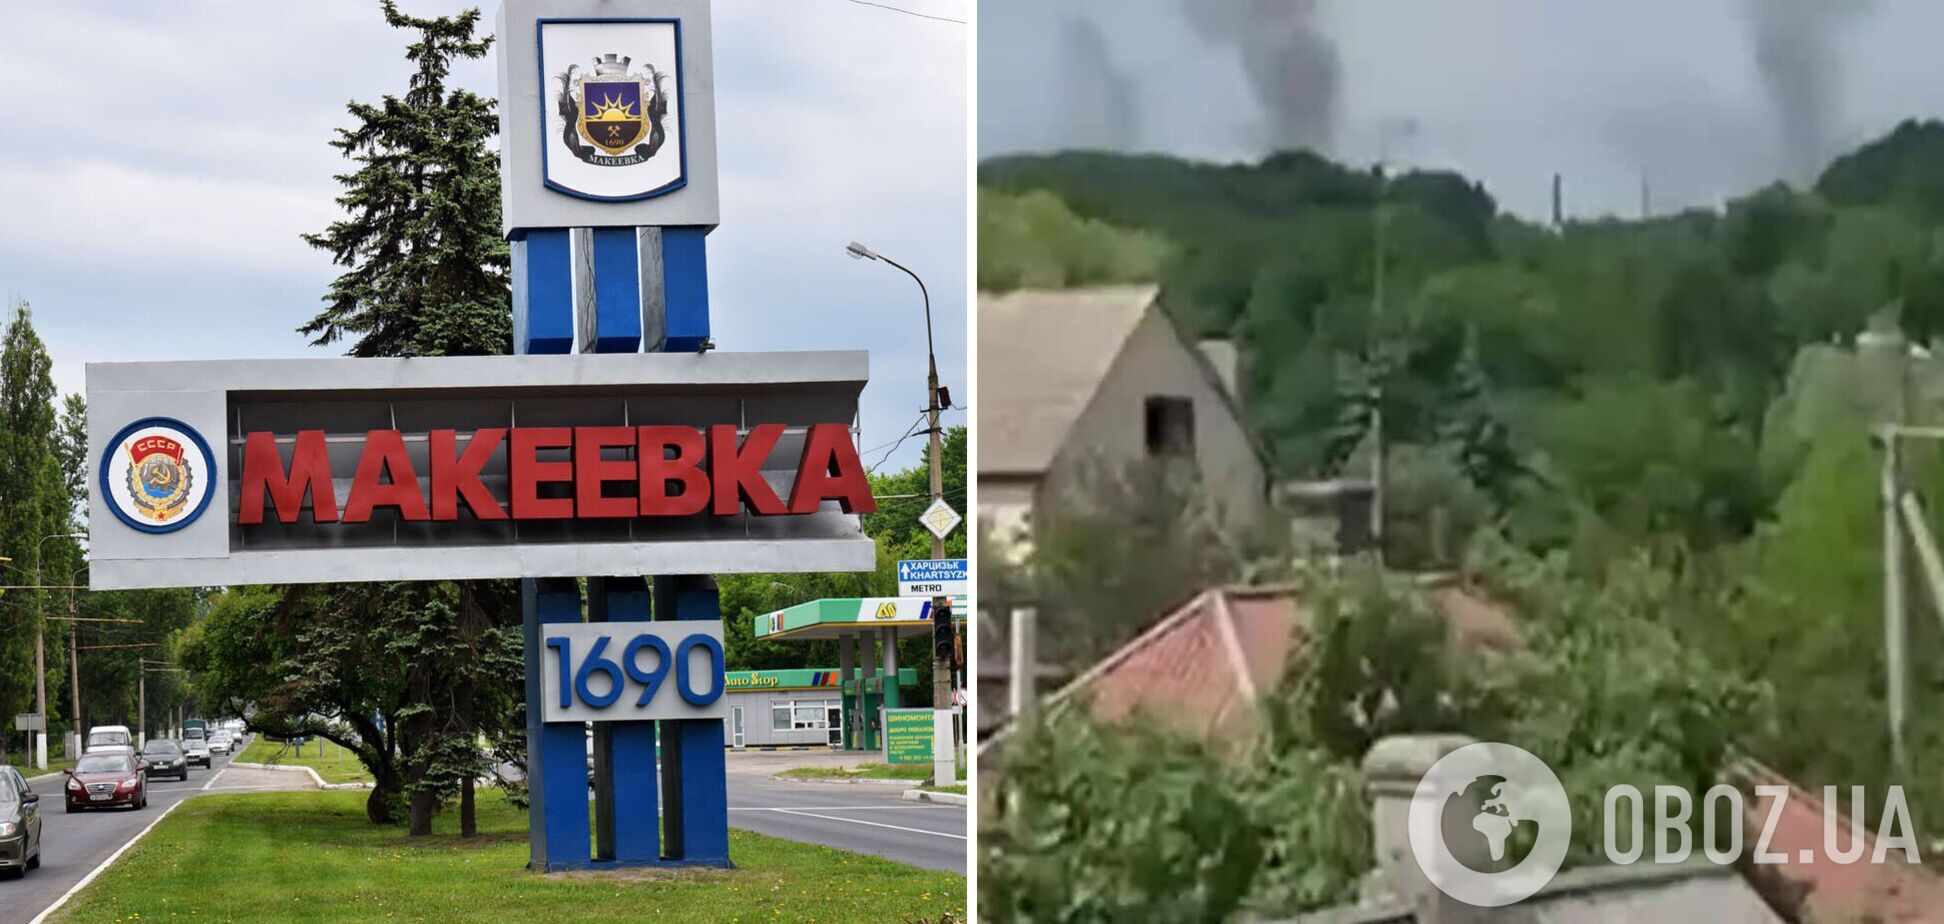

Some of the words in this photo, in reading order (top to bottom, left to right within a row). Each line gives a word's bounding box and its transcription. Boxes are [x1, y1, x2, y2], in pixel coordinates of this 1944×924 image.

[588, 154, 645, 166] МАКЕЕВКА
[136, 440, 176, 453] СССР
[238, 423, 878, 526] МАКЕЕВКА
[910, 561, 959, 572] ХАРЦИЗЬК
[911, 584, 942, 593] METRO
[545, 633, 726, 709] 1690
[751, 671, 779, 687] Stop
